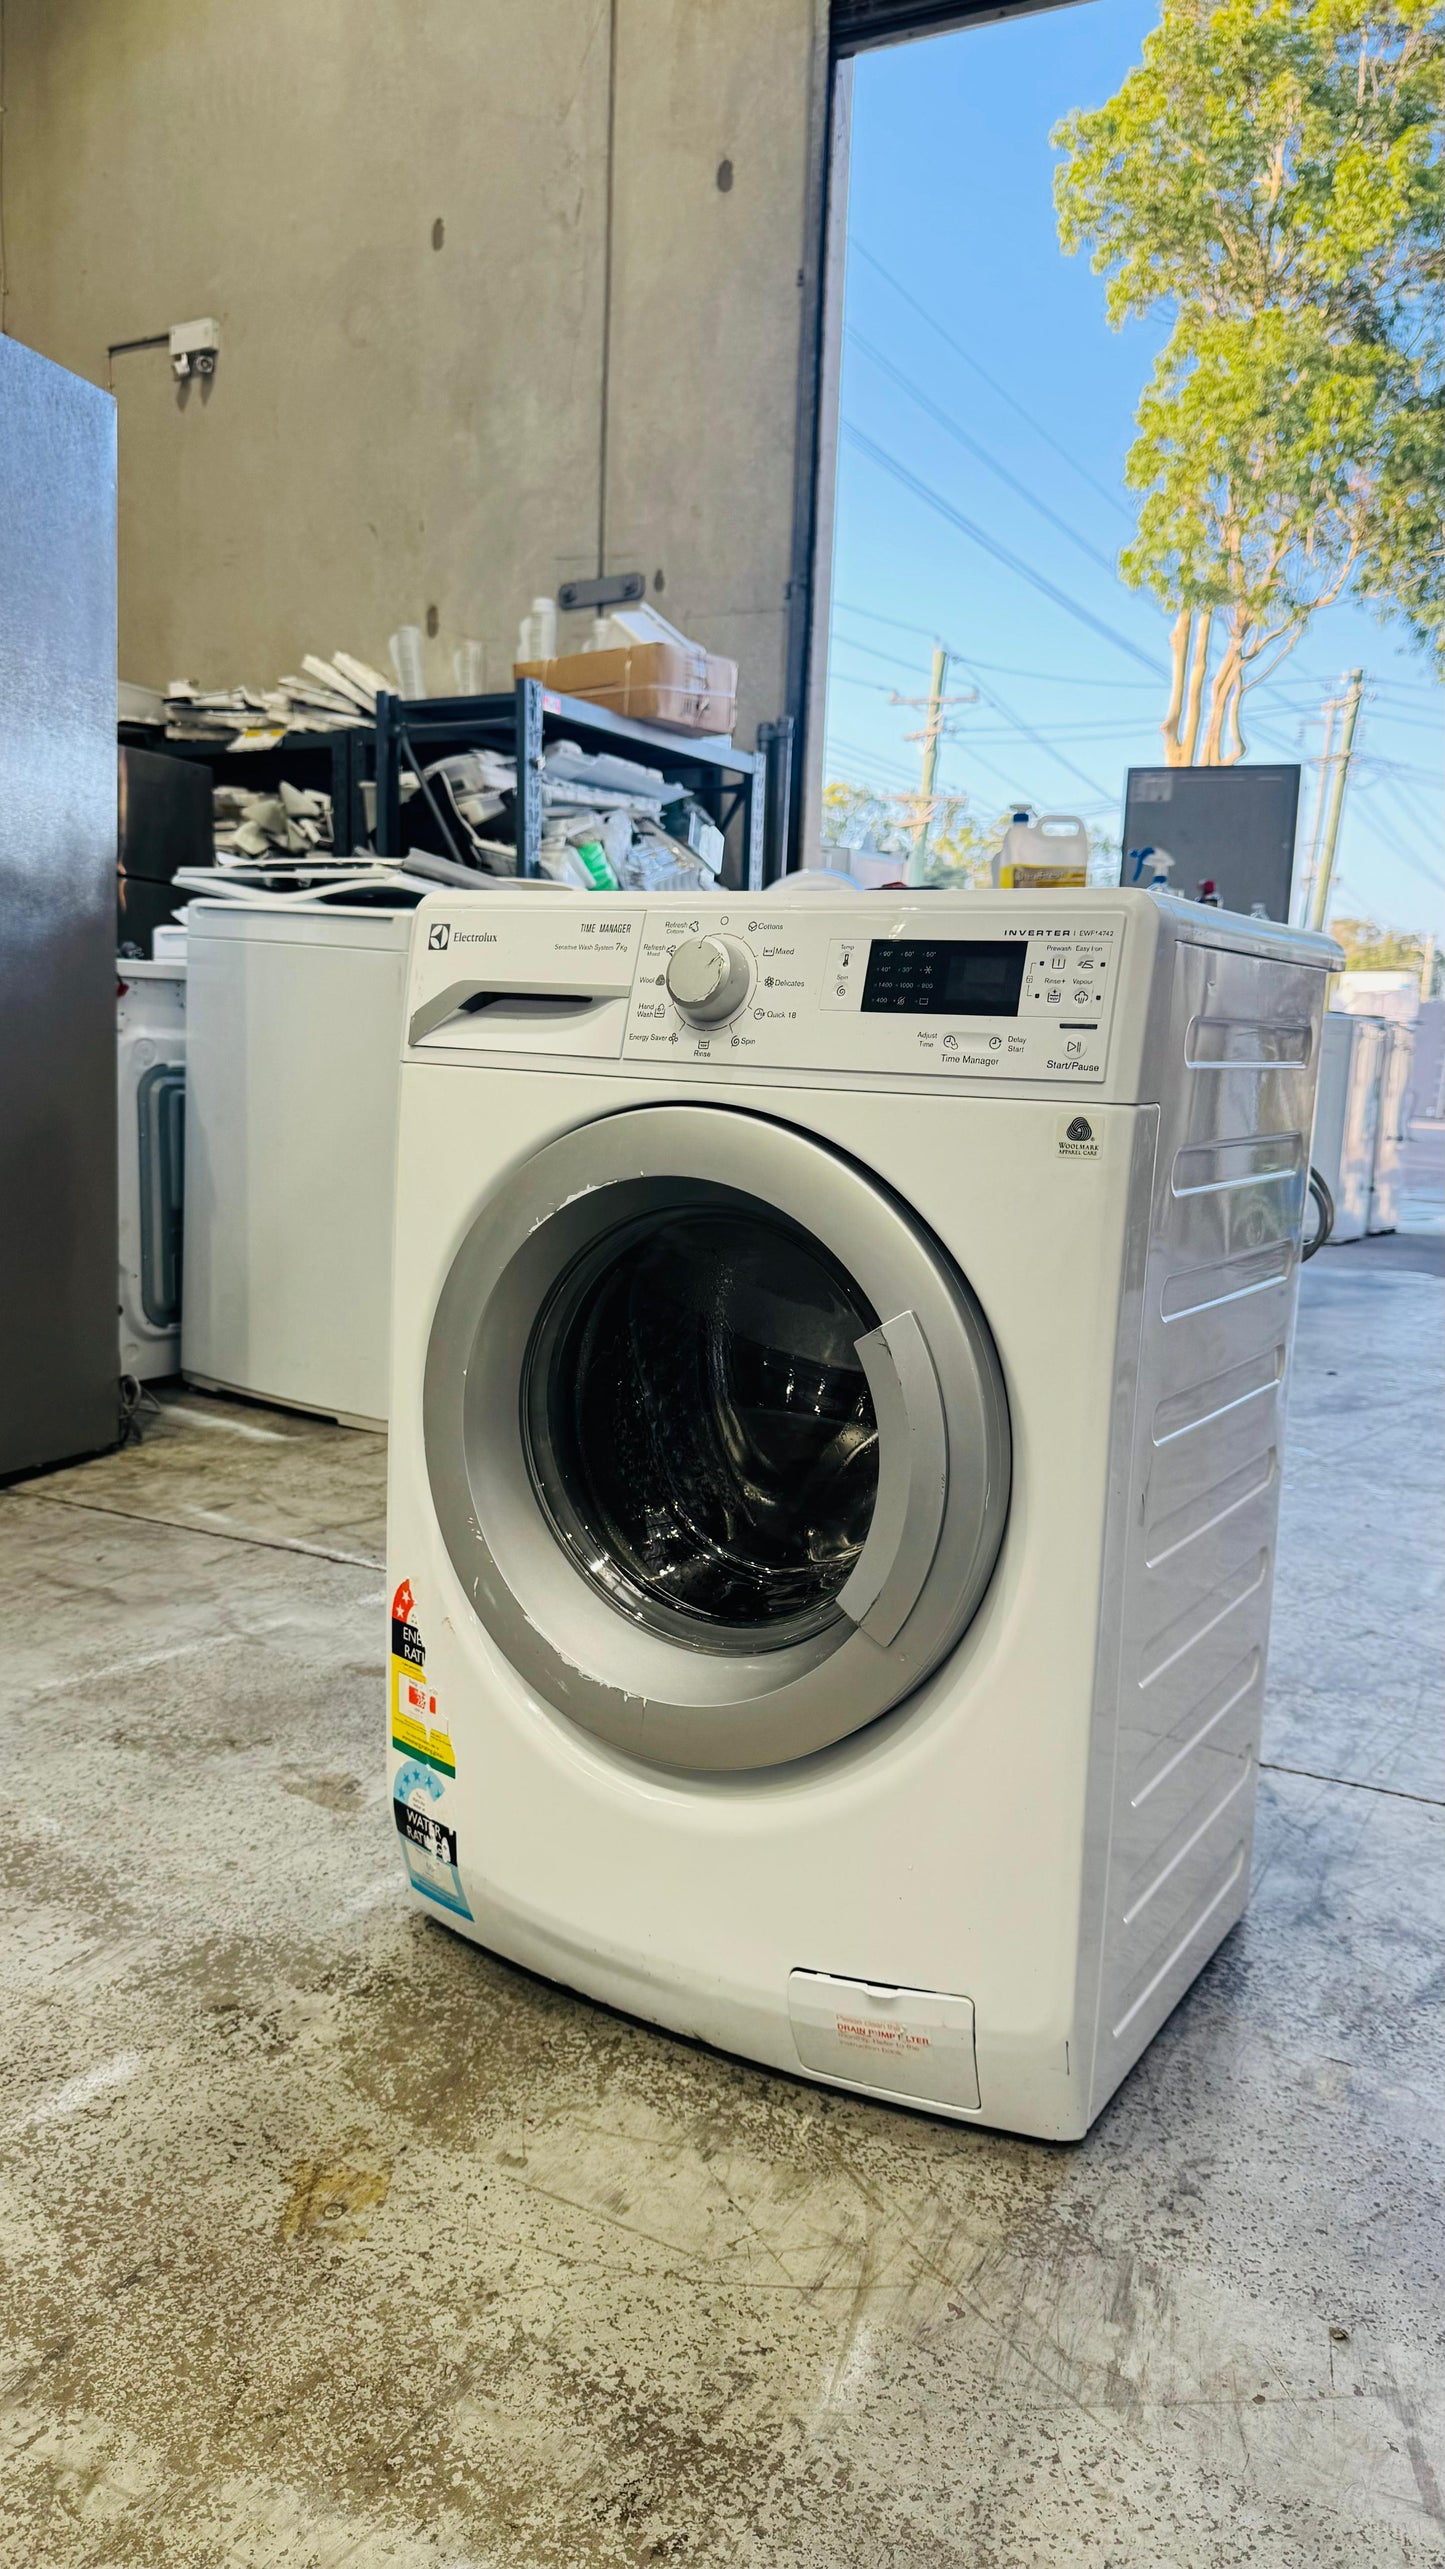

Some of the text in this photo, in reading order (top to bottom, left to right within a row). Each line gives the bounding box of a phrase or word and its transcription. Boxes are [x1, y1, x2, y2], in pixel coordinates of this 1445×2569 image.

[580, 923, 632, 934] TIME MANAGER
[665, 921, 688, 929] Refresh
[758, 922, 783, 931] Cottons
[453, 932, 498, 943] Electrolux
[643, 943, 666, 951] Refresh
[775, 947, 795, 956] Mixed
[1075, 945, 1090, 953] Easy
[640, 976, 655, 984] Wool
[775, 979, 805, 988] Delicates
[766, 1010, 786, 1019] Quick
[629, 1033, 668, 1043] Energy Saver
[917, 1031, 938, 1040] Adjust
[1007, 1035, 1027, 1044] Delay
[741, 1037, 756, 1046] Spin
[919, 1040, 934, 1048] Time
[694, 1049, 711, 1058] Rinse
[1007, 1045, 1025, 1053] Start
[941, 1053, 1000, 1067] Time Manager
[1046, 1060, 1100, 1072] Start/Pause
[1058, 1142, 1099, 1151] WOOLMARK
[837, 2023, 866, 2035] DRAIN
